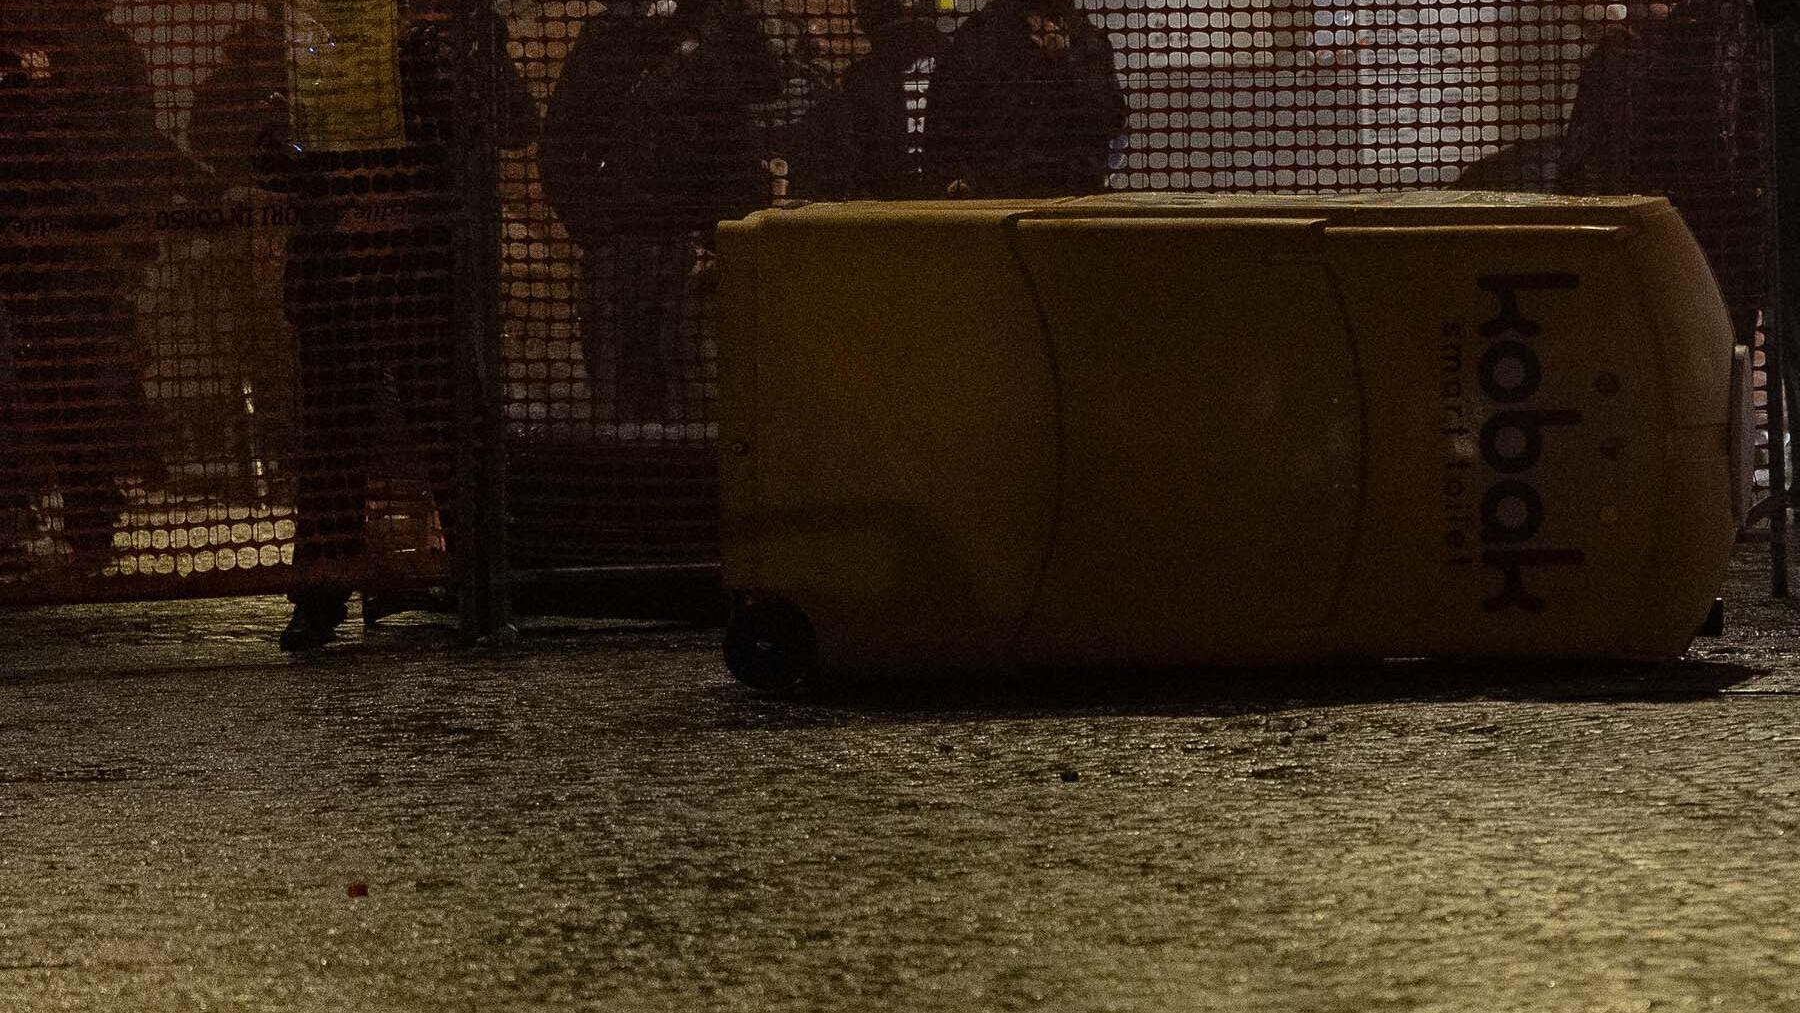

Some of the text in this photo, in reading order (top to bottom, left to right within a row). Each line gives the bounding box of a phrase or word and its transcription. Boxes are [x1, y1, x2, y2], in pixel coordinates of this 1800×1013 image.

[1440, 320, 1474, 568] smart toilet
[1478, 272, 1586, 613] kobak
